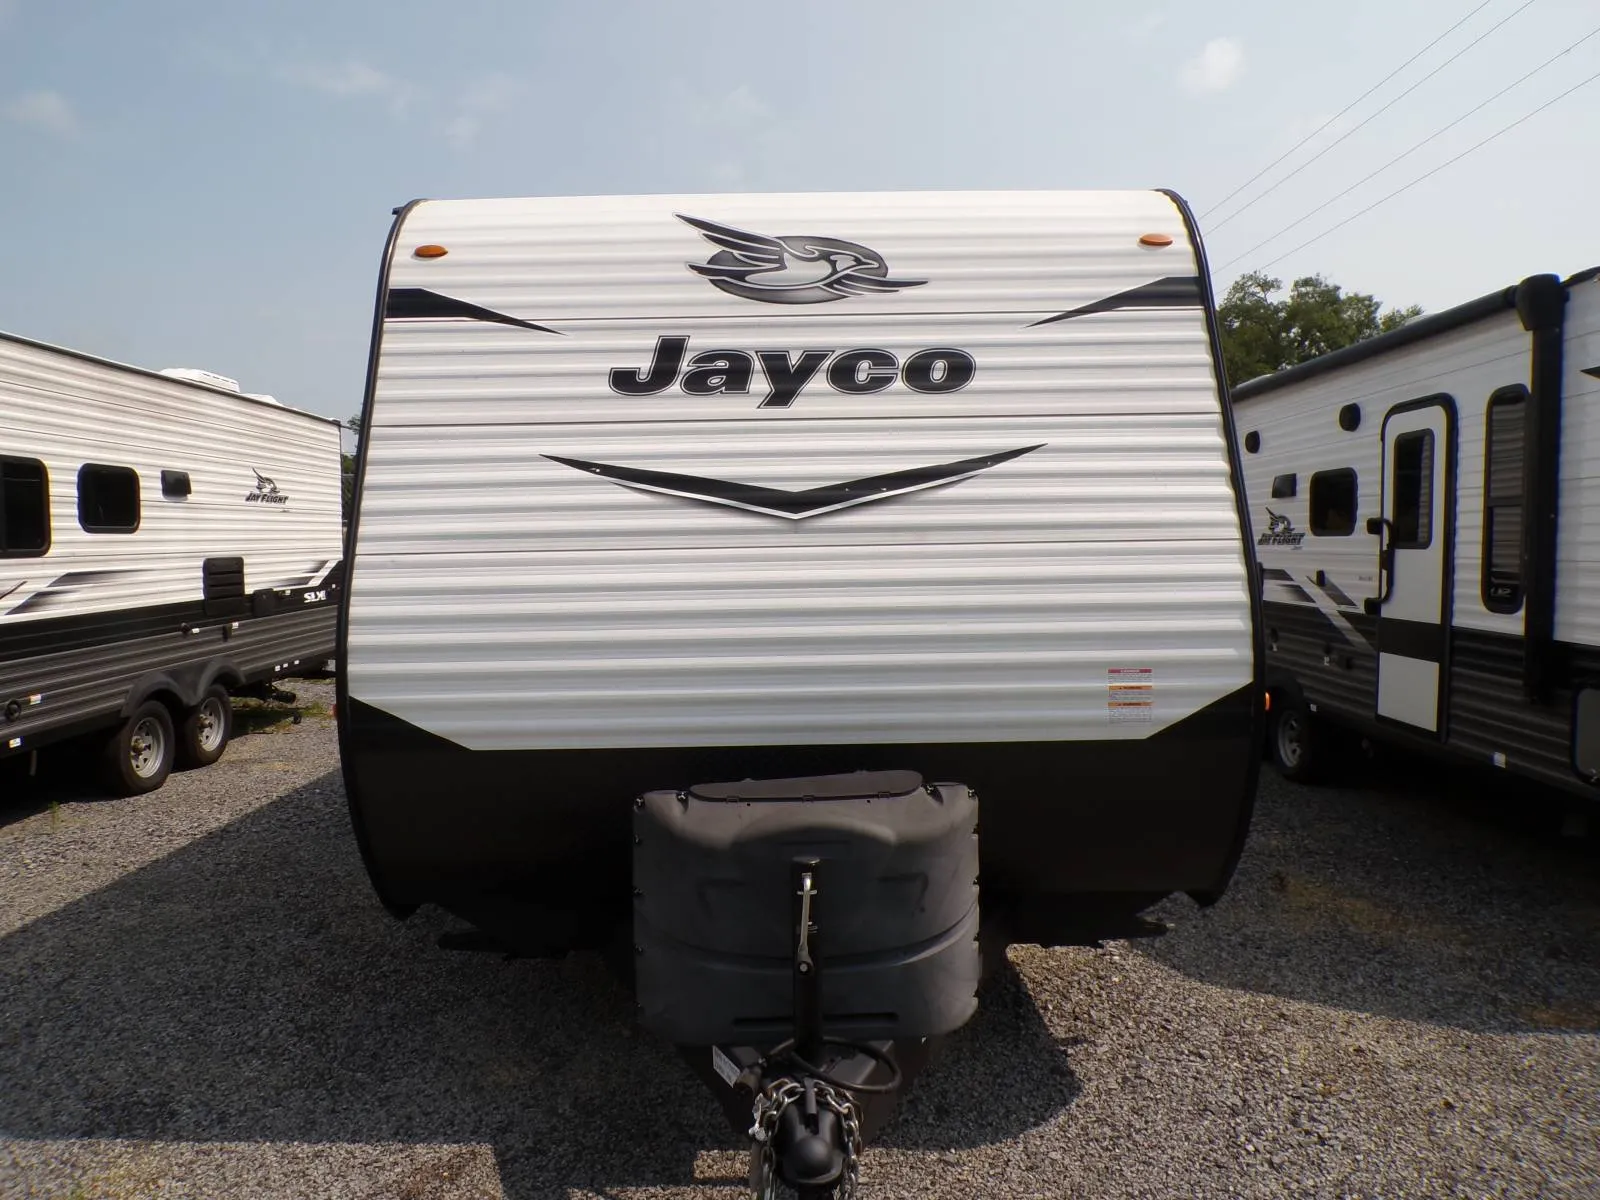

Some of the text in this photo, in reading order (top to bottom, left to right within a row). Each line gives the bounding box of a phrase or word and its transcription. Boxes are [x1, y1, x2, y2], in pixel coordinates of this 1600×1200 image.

[608, 335, 976, 409] Jayco
[245, 492, 289, 504] JAY FLIGHT
